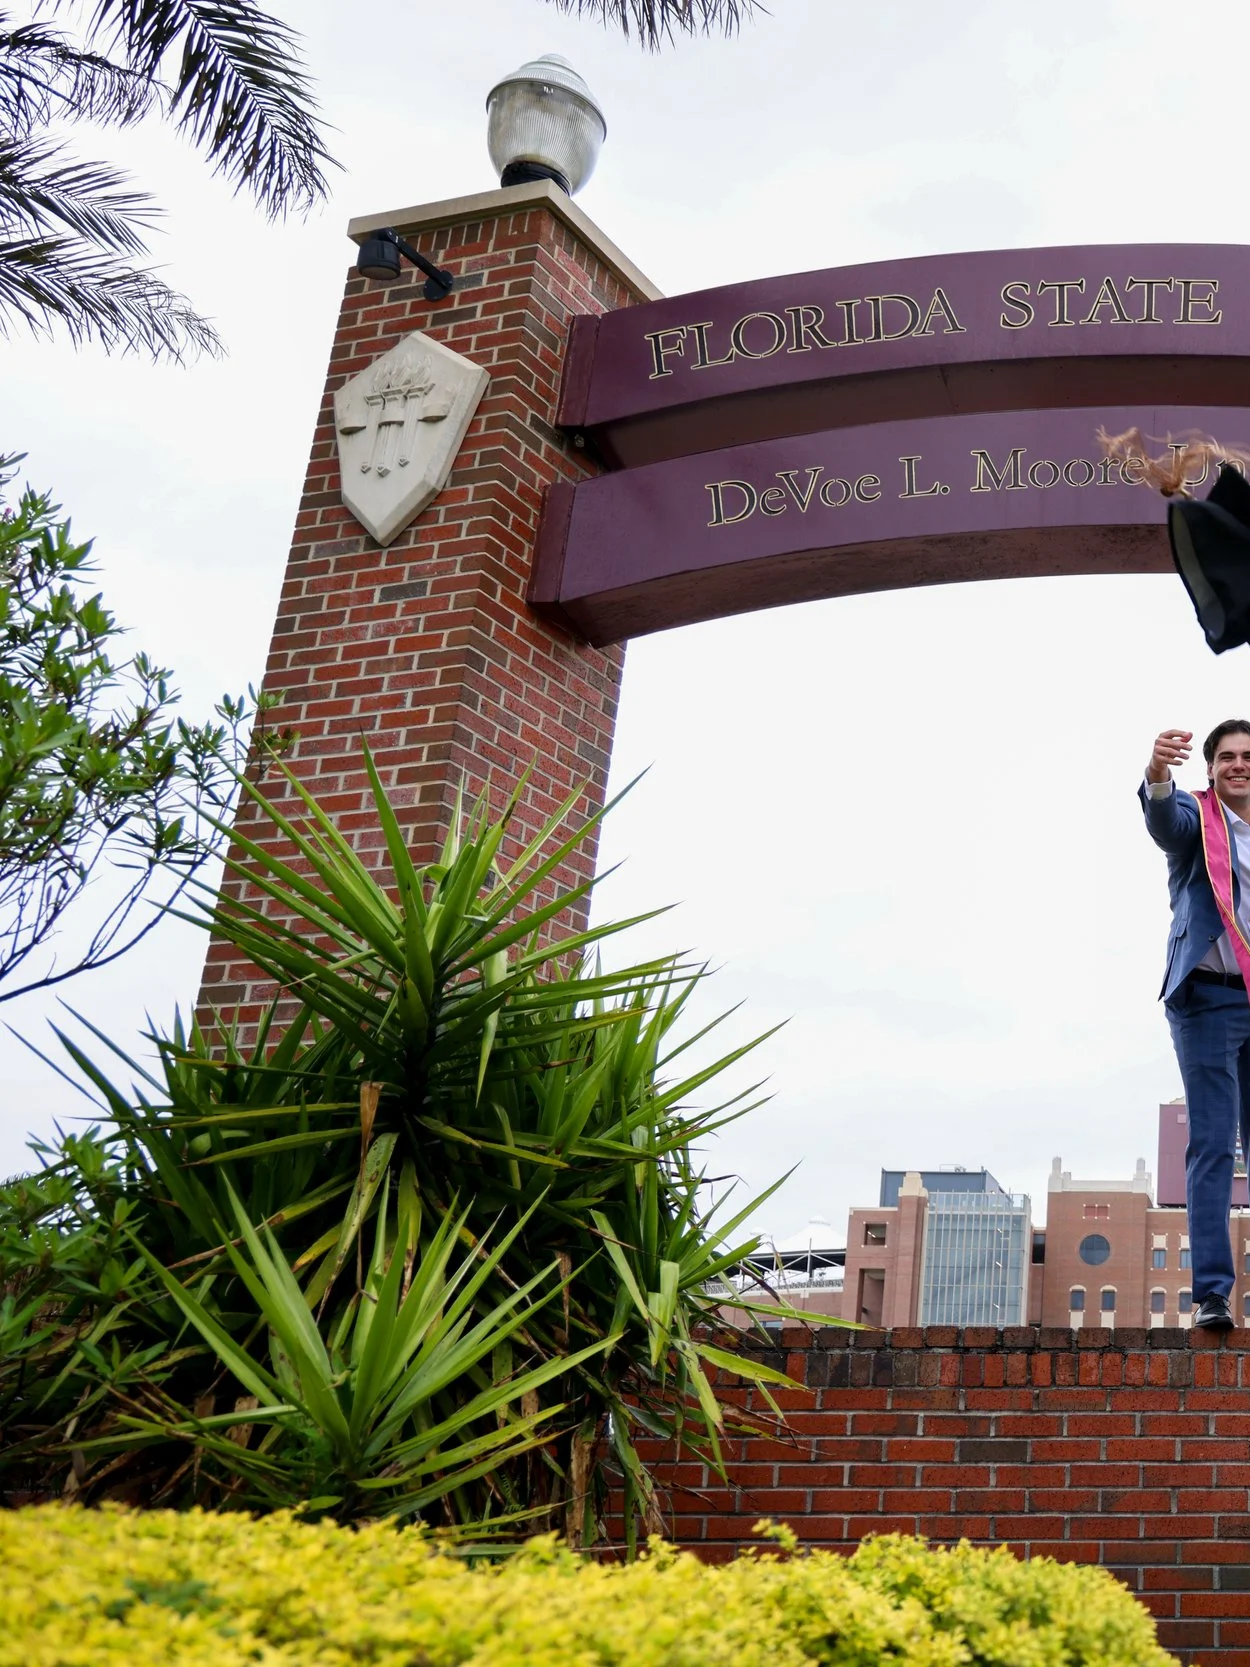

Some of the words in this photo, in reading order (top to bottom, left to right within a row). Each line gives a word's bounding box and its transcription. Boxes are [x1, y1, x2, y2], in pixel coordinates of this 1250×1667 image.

[645, 287, 966, 379] FLORIDA
[1000, 276, 1222, 329] STATE
[706, 466, 881, 527] DeVoe
[898, 455, 951, 501] L.
[970, 447, 1146, 493] Moore
